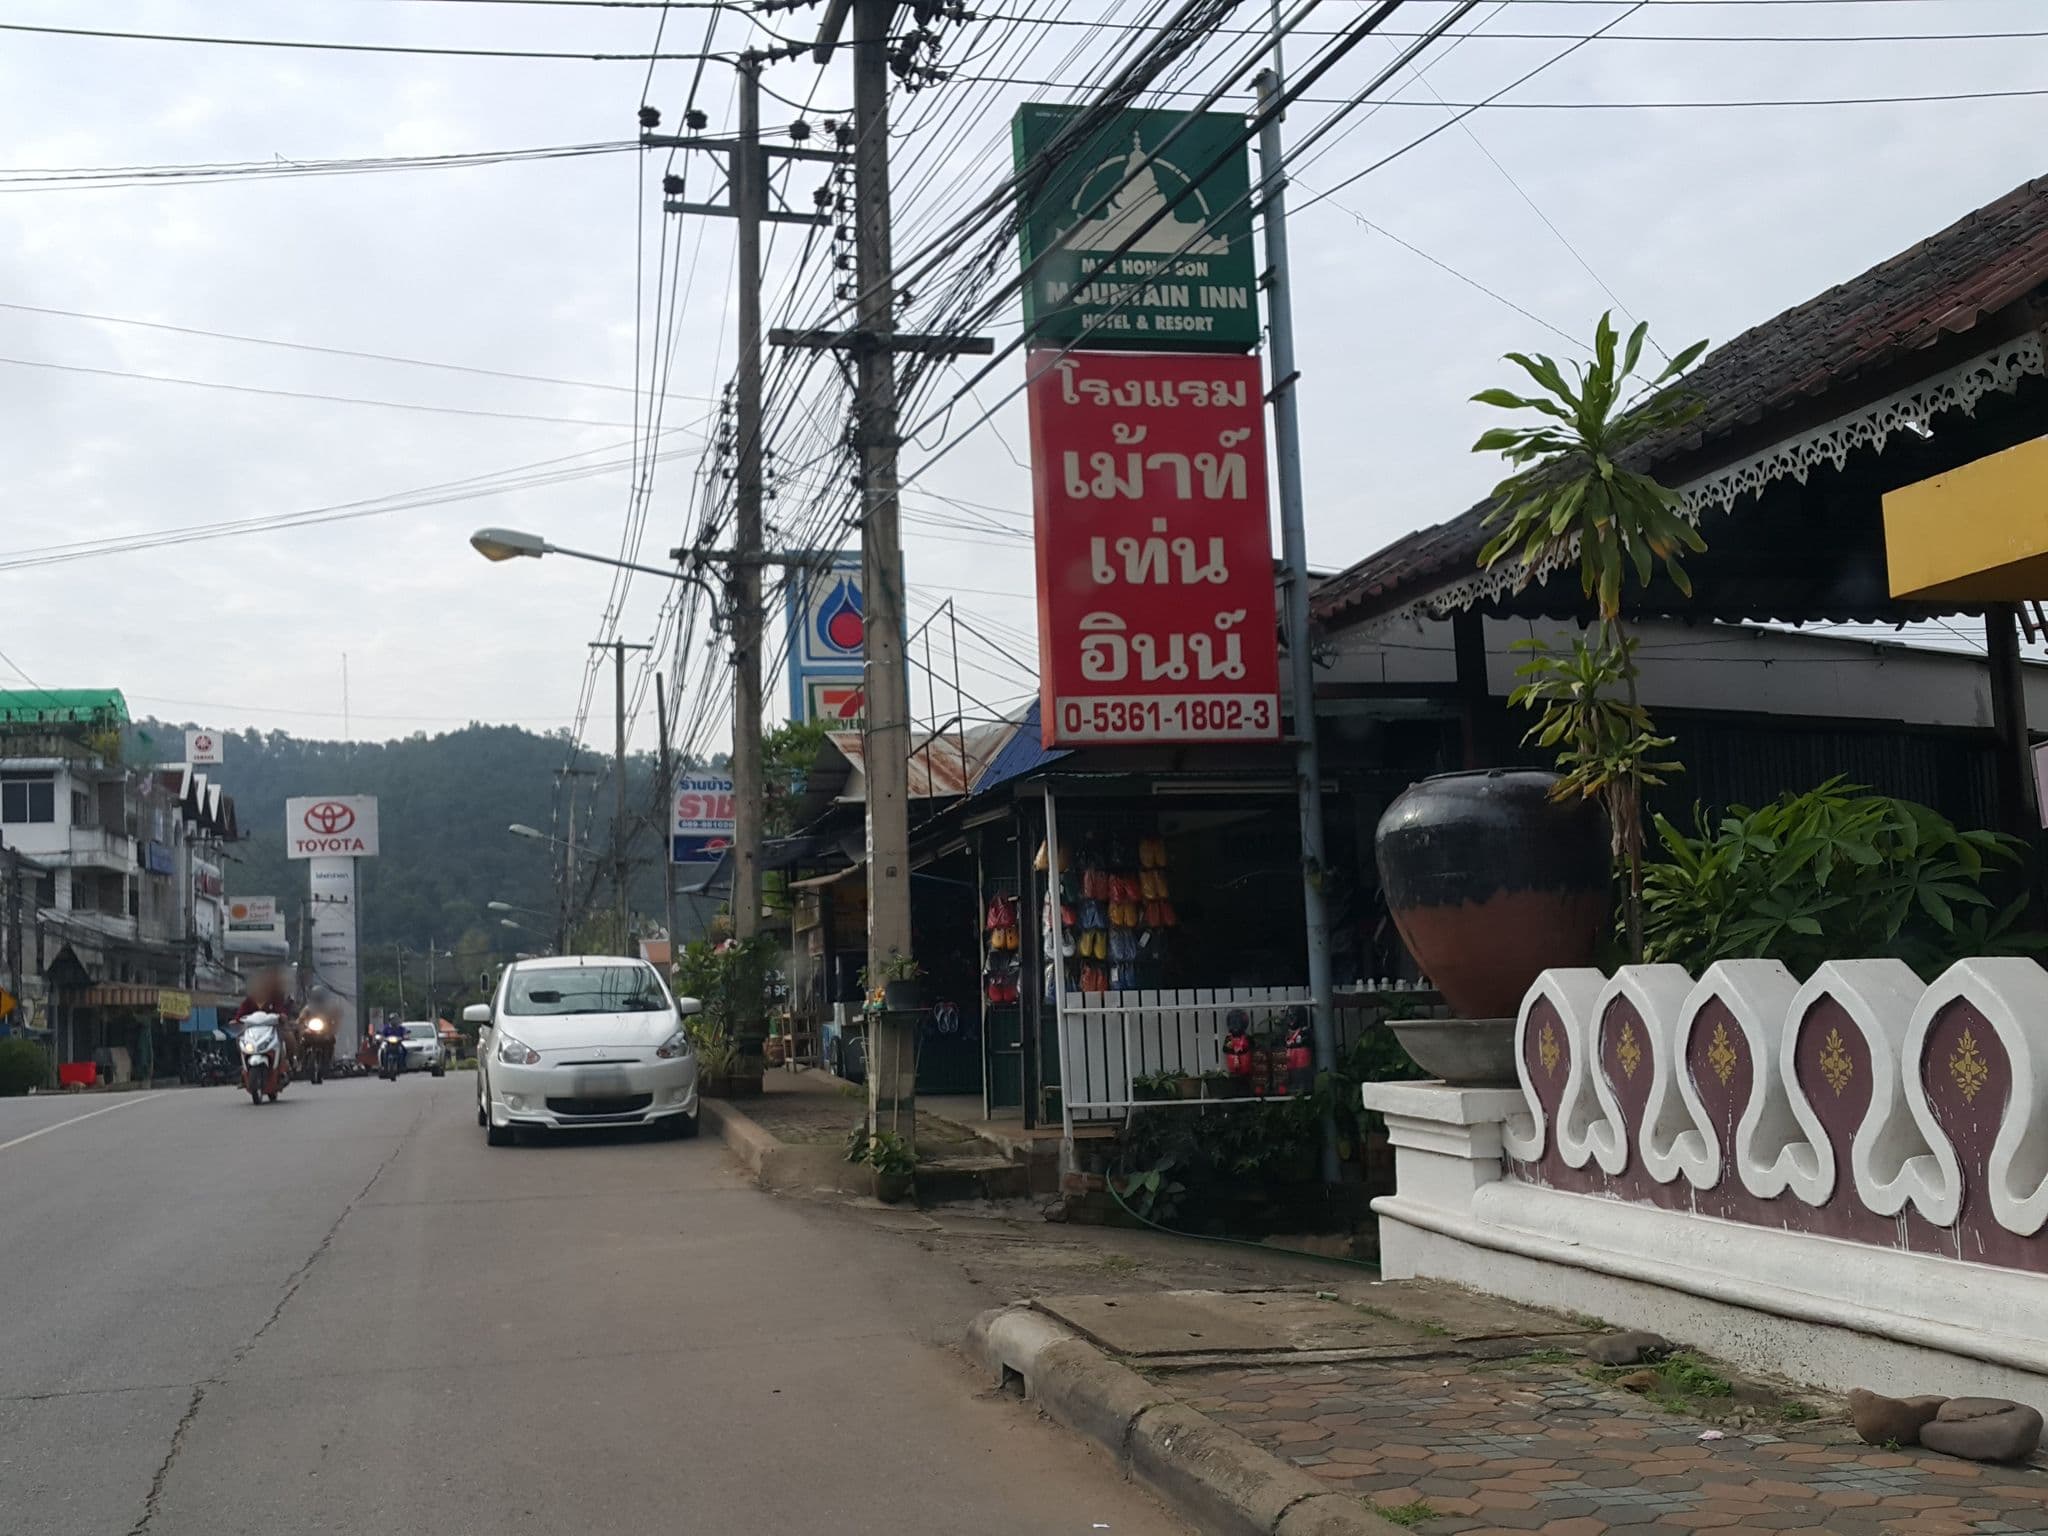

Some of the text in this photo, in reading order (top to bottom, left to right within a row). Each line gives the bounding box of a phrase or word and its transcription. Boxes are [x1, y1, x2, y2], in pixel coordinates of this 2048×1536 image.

[1199, 285, 1248, 309] INN
[1082, 313, 1214, 331] HOTEL & RESORT
[1055, 359, 1247, 407] โรงแรม
[1063, 423, 1251, 499] เม้าท์
[1090, 517, 1229, 585] เท่น
[1079, 609, 1247, 681] อินน์
[1064, 700, 1270, 734] 0-5361-1802-3
[296, 838, 365, 852] TOYOTA
